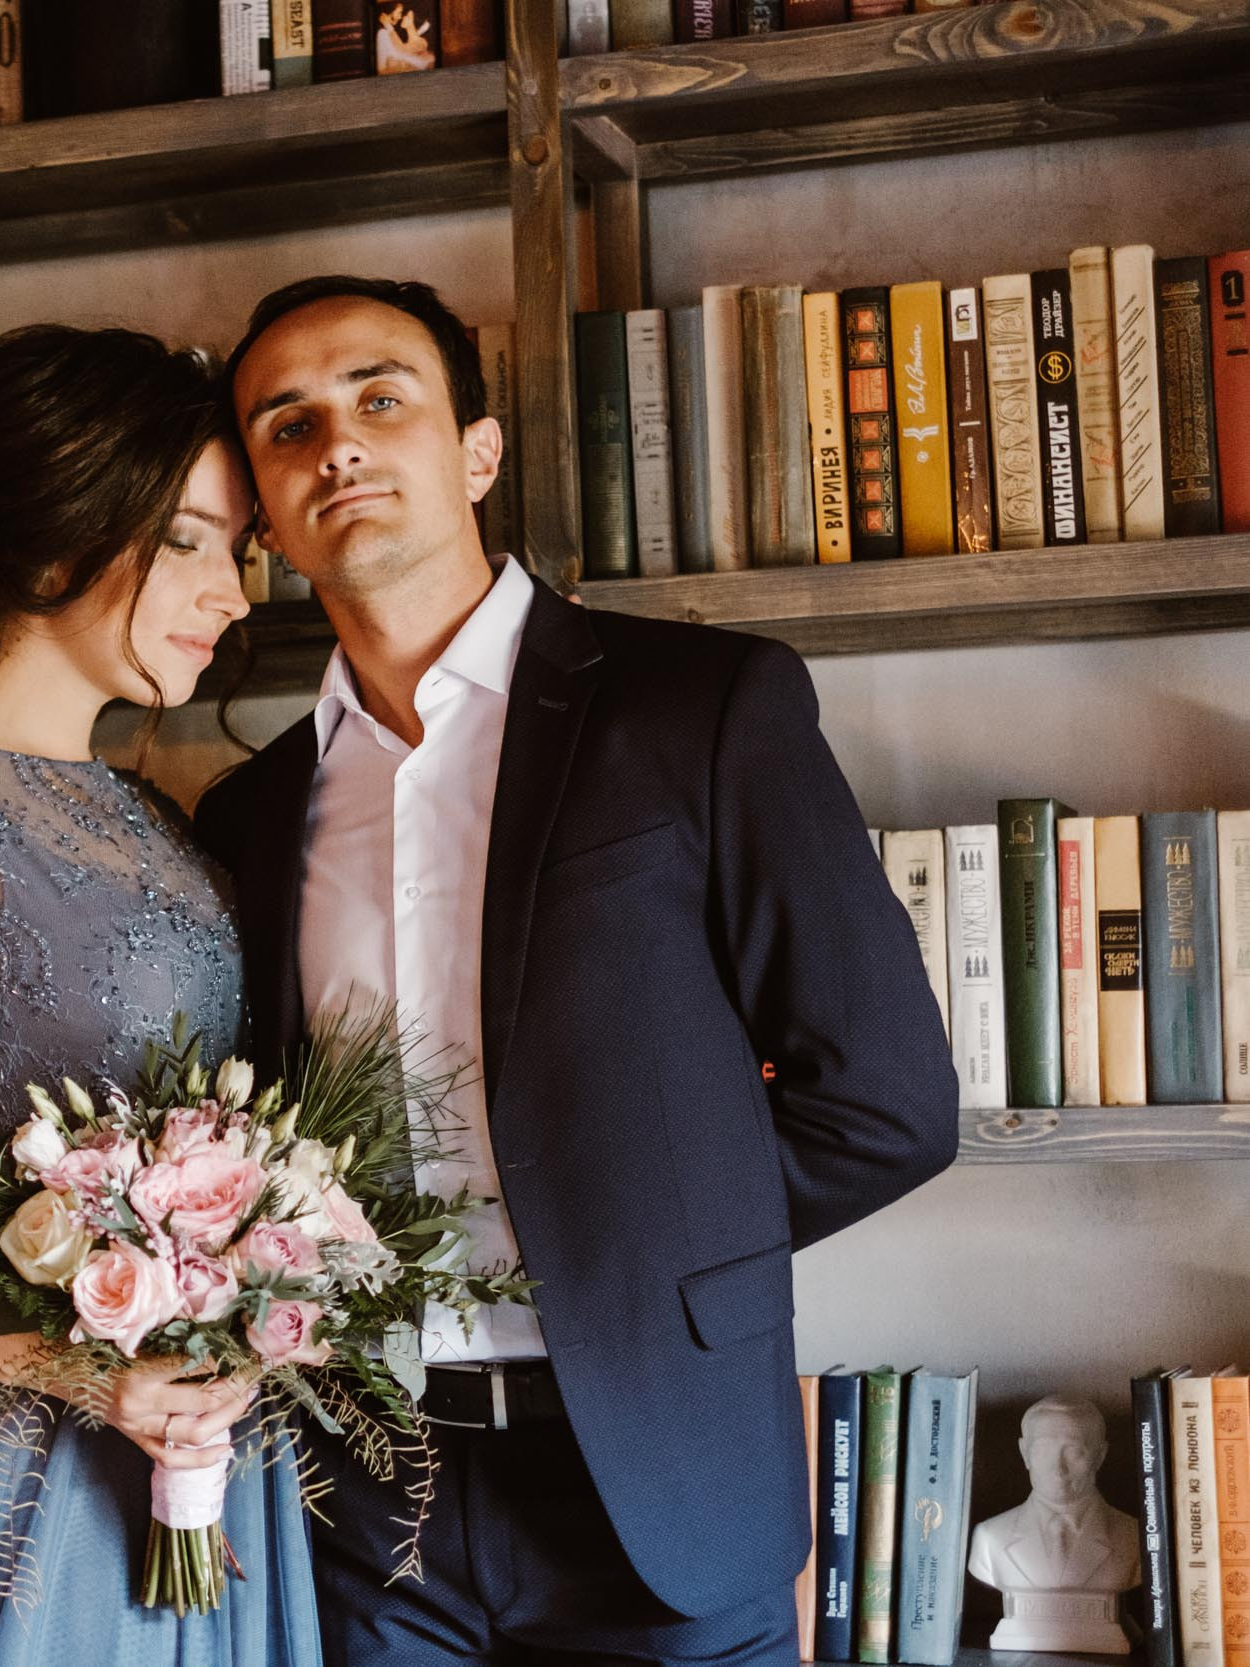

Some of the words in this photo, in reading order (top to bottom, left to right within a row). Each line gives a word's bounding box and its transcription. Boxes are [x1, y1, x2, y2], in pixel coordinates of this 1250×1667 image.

[1051, 290, 1066, 339] ДРАЙЗЕР
[1225, 276, 1240, 300] 1
[1041, 297, 1053, 339] ТЕОДОР
[819, 446, 843, 530] ВИРИНЕЯ
[1047, 402, 1076, 538] ФИНАНСИСТ
[960, 879, 989, 950] МУЖЕСТВО
[1166, 870, 1194, 940] МУЖЕСТВО
[1065, 1041, 1079, 1085] Эрнест
[834, 1419, 850, 1478] РИСКУЕТ
[1140, 1421, 1156, 1473] портреты
[1185, 1415, 1201, 1472] ЛОНДОНА
[830, 1482, 849, 1537] МЕЙСОН
[1190, 1478, 1200, 1494] ИЗ
[1190, 1499, 1204, 1556] ЧЕЛОВЕК
[910, 1553, 929, 1631] Преступление
[926, 1555, 940, 1611] наказание
